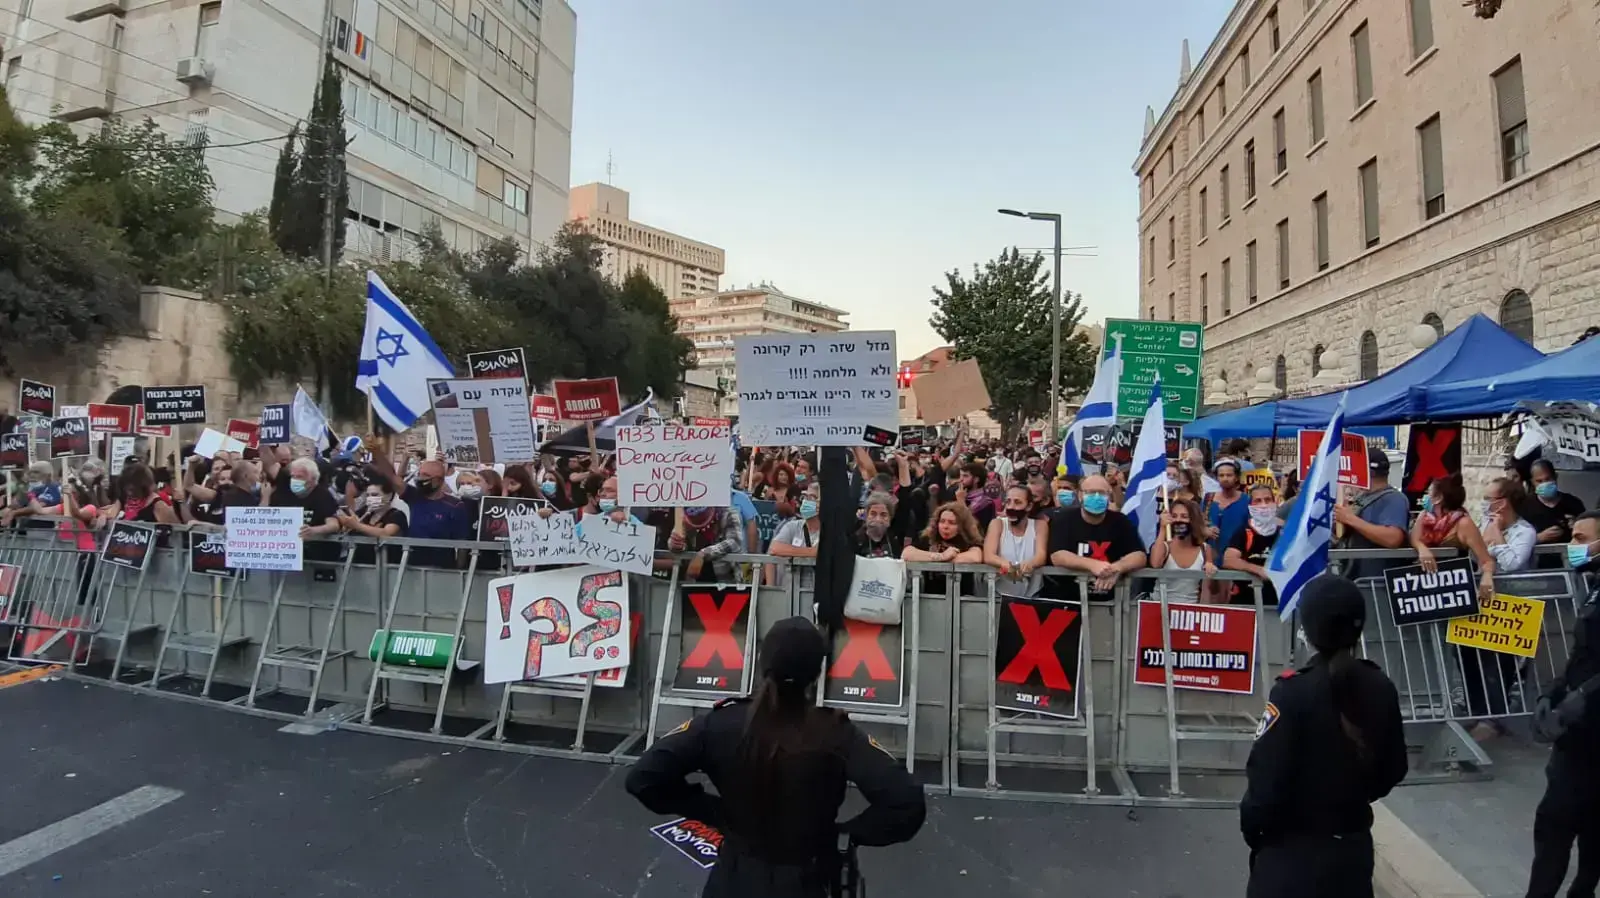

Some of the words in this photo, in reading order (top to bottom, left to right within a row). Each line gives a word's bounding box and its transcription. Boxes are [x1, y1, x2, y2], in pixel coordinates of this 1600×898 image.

[1131, 324, 1150, 332] העיר
[1155, 325, 1177, 333] מרכז
[753, 345, 791, 356] קורונה
[799, 344, 816, 356] רק
[829, 343, 856, 353] שזה
[866, 340, 890, 352] מזל
[812, 366, 857, 379] מלחמה
[871, 364, 891, 375] ולא
[184, 389, 201, 398] ביבי
[463, 390, 482, 401] עם
[490, 387, 522, 398] עקדת
[739, 389, 773, 401] לגמרי
[776, 390, 817, 400] אבודים
[824, 390, 851, 399] היינו
[861, 389, 876, 399] אז
[880, 389, 892, 399] כי
[179, 400, 193, 408] אל
[262, 407, 284, 425] המלך
[617, 426, 655, 443] 1933
[663, 426, 729, 441] ERROR:
[775, 425, 815, 436] הבייתה
[827, 424, 862, 436] נתניהו
[618, 447, 719, 469] Democracy
[651, 466, 693, 480] NOT
[632, 481, 708, 502] FOUND
[247, 528, 268, 537] ישראל
[268, 529, 289, 537] מדינת
[279, 542, 296, 551] בנימין
[1392, 568, 1469, 594] ממשלת
[1399, 589, 1472, 616] הבושה!
[1512, 601, 1533, 616] לא
[1170, 609, 1225, 634] שחיתות
[1468, 614, 1524, 631] להילחם
[1453, 624, 1510, 646] המדינה!
[391, 636, 437, 657] שחיתות
[1514, 634, 1534, 650] על
[1179, 652, 1214, 668] בבטחון
[696, 676, 713, 685] מצב
[843, 686, 860, 695] מצב
[1016, 692, 1033, 703] מצב
